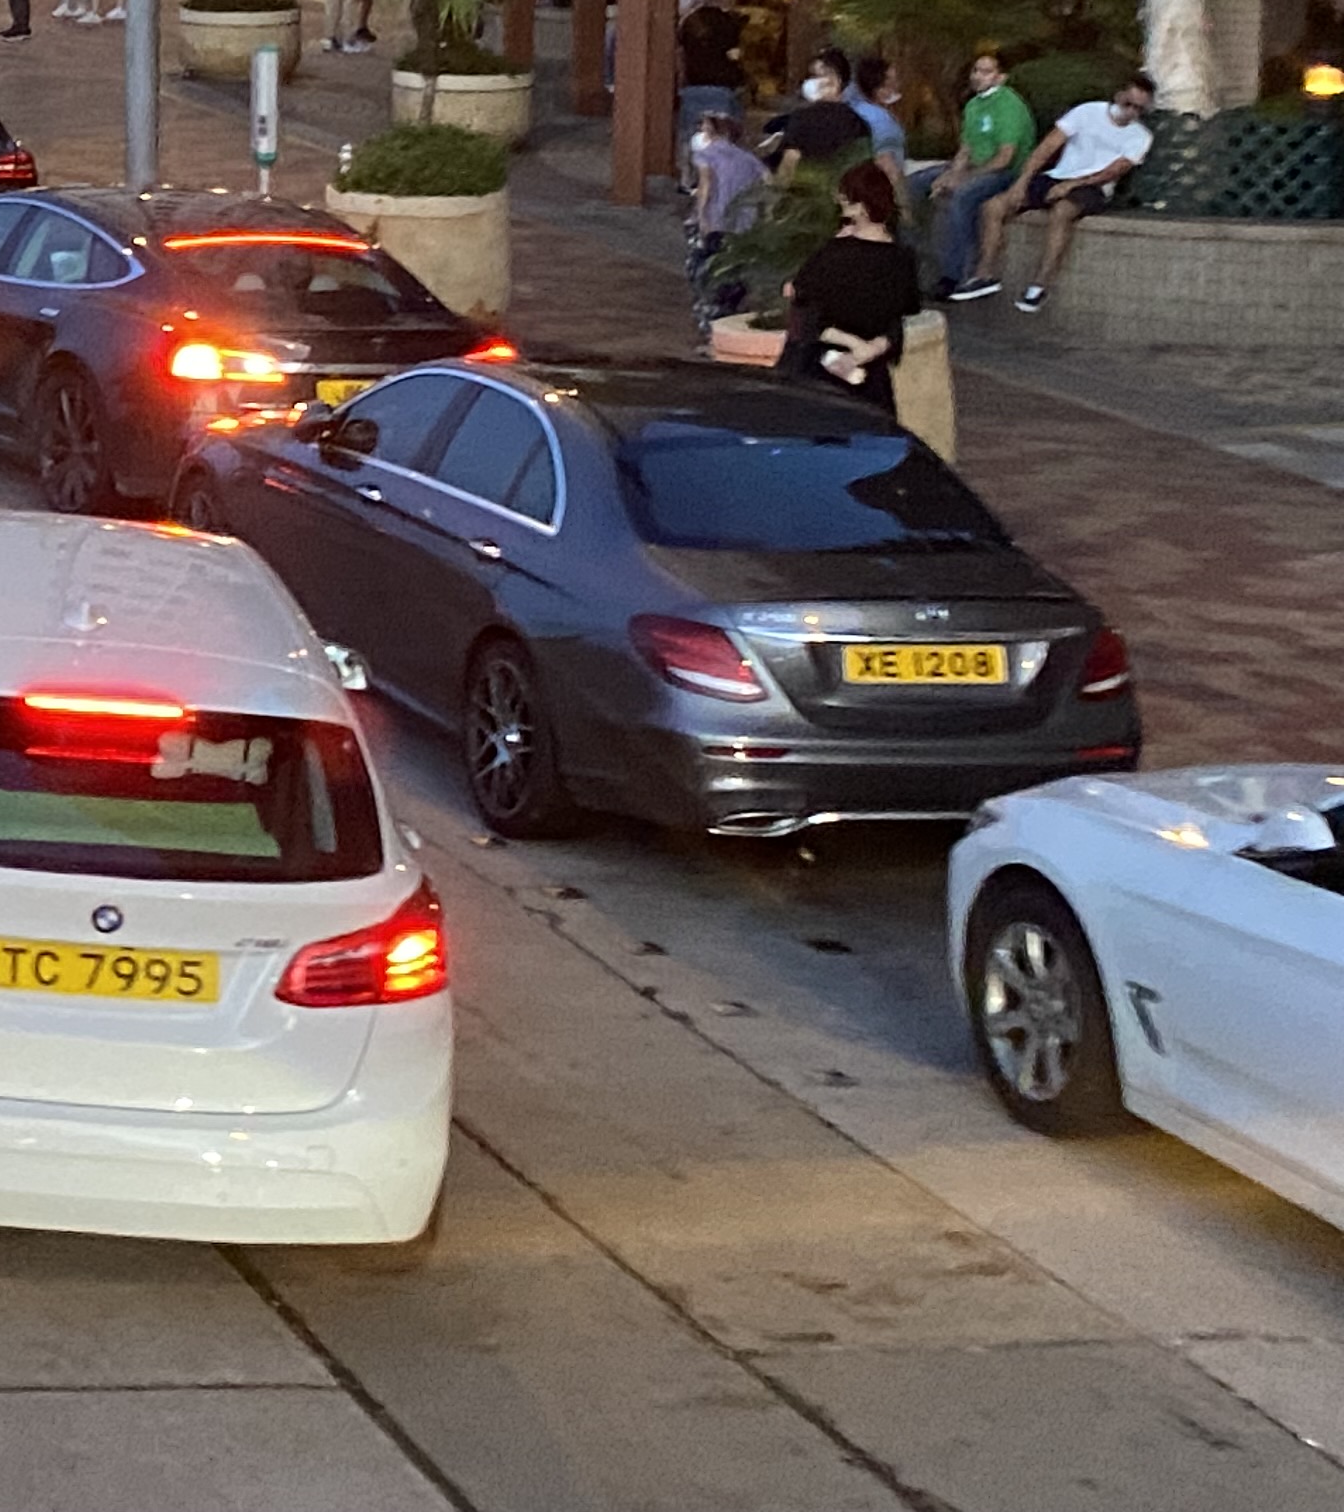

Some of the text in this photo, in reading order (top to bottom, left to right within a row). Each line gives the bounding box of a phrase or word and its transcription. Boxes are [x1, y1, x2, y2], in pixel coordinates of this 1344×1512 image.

[857, 651, 995, 678] XE 1208
[2, 946, 203, 996] TC 7995
